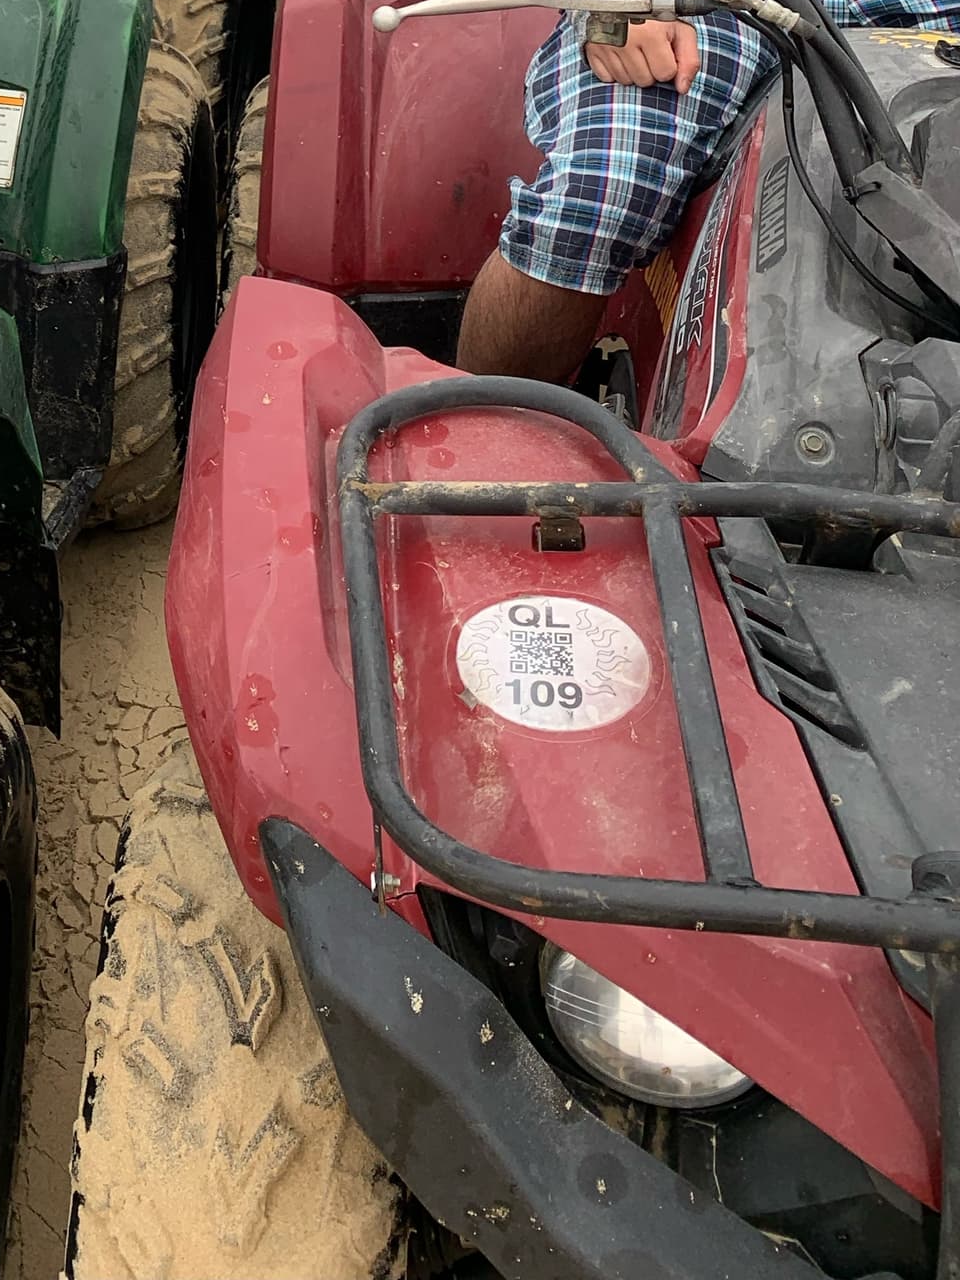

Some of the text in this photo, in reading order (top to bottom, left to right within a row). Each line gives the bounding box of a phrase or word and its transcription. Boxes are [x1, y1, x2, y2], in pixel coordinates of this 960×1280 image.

[758, 165, 787, 265] YAMAHA
[508, 604, 570, 628] QL
[505, 679, 583, 709] 109
